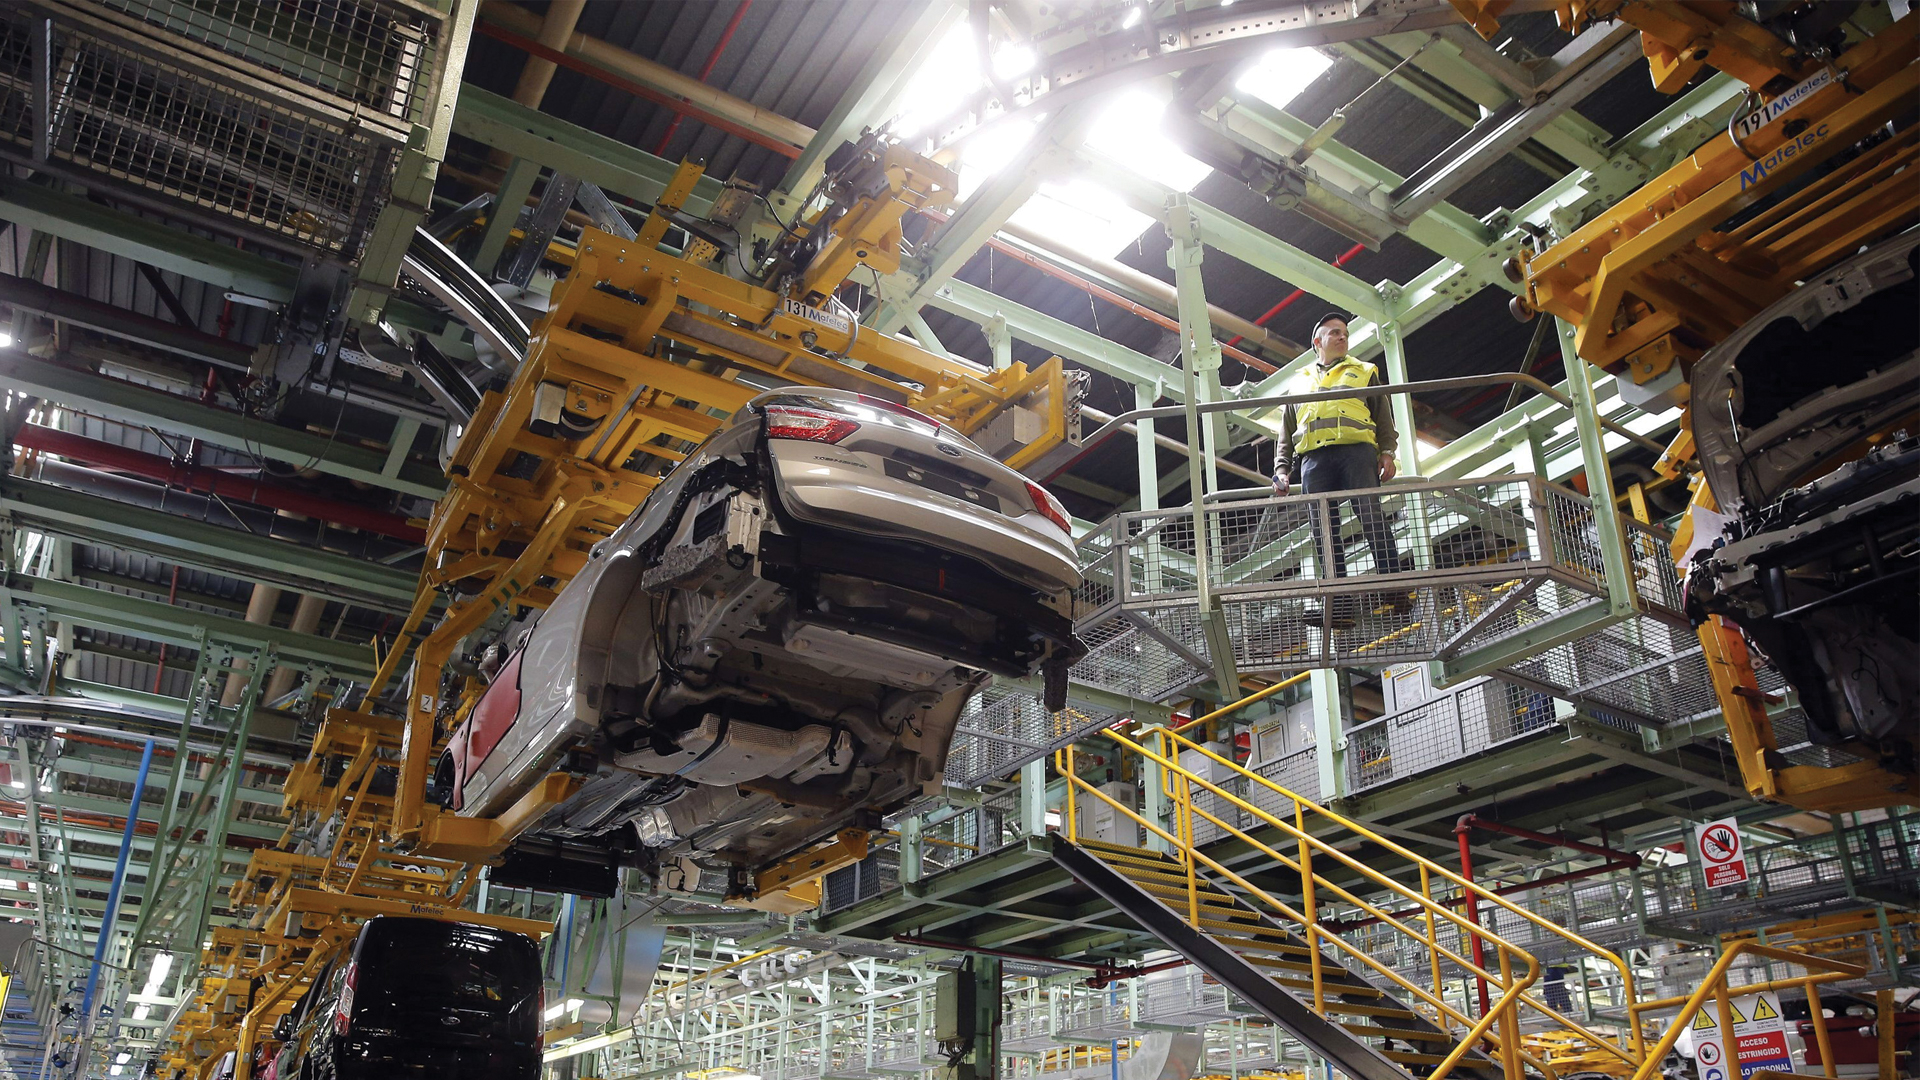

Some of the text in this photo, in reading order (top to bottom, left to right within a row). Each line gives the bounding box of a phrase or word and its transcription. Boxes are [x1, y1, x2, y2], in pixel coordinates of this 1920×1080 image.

[1741, 105, 1772, 136] 191
[1773, 72, 1829, 116] Mafelec
[1740, 123, 1830, 191] Mafelec
[786, 299, 807, 318] 131
[809, 309, 848, 330] Mafelec
[1713, 869, 1738, 879] PERSONAL
[1718, 864, 1731, 872] SOLO
[1712, 874, 1742, 886] AUTORIZADO
[410, 904, 445, 916] Mafelec
[1740, 1037, 1768, 1048] ACCESO
[1737, 1047, 1781, 1060] ESTRINGIDO
[1740, 1068, 1751, 1076] LO
